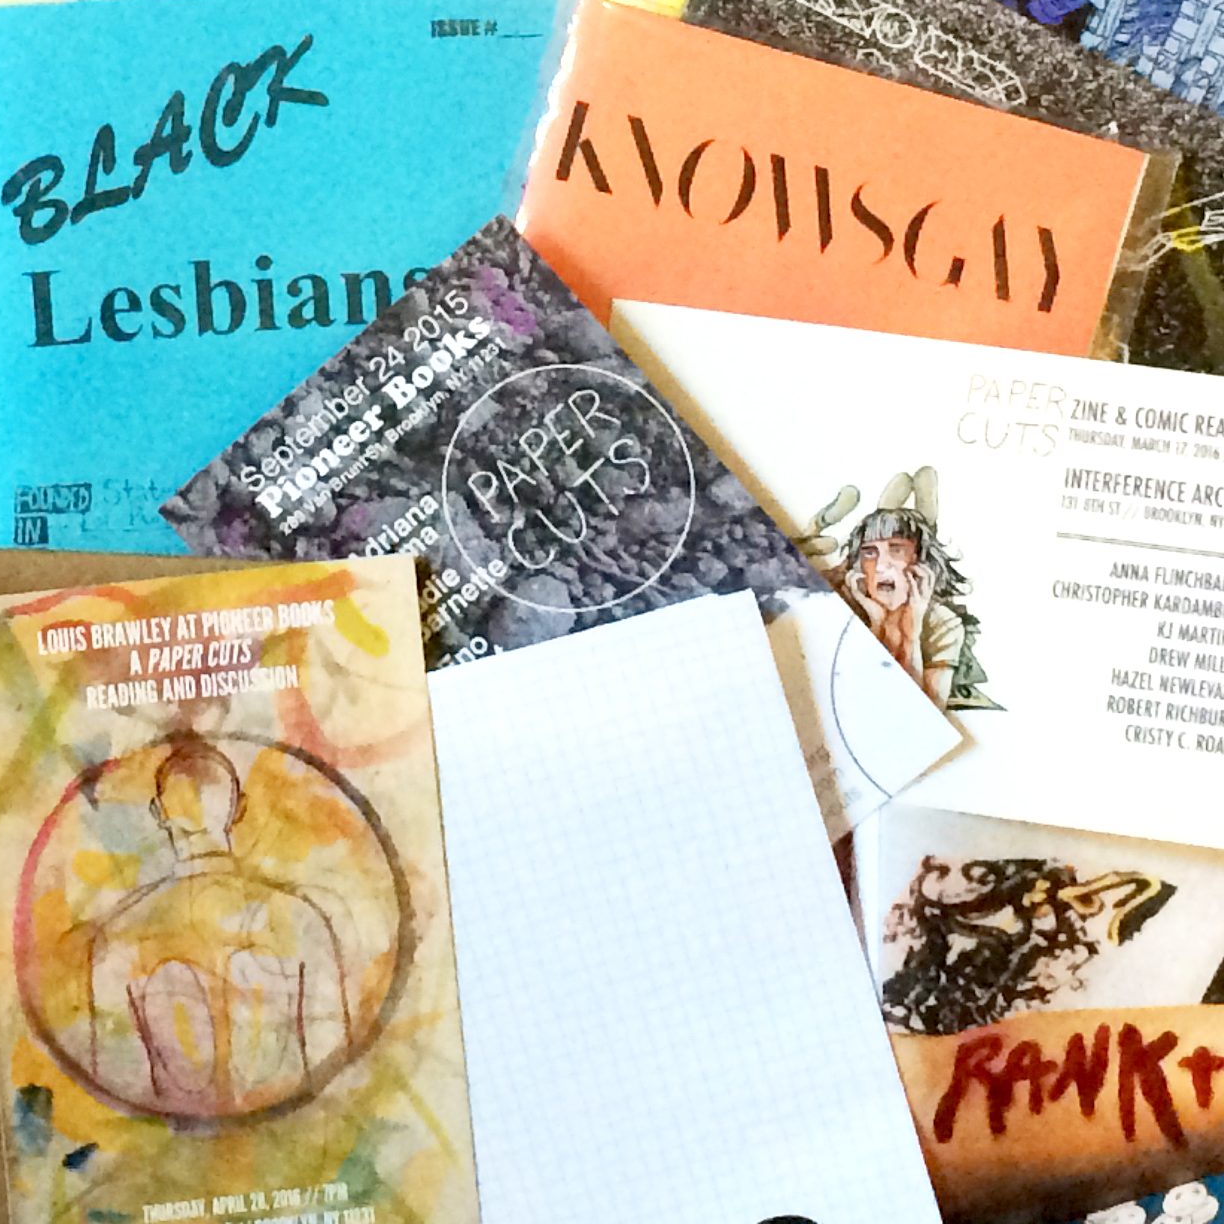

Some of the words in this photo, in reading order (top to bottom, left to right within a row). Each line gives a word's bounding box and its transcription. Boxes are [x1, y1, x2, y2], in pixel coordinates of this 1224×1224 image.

[431, 18, 481, 39] ISSUE
[0, 33, 330, 246] BLACK
[240, 374, 371, 493] September
[368, 344, 407, 384] 24
[403, 288, 470, 354] 2015
[967, 373, 1068, 419] PAPER
[254, 404, 385, 520] Pioneer
[381, 315, 493, 410] Books
[957, 411, 1060, 458] CUTS
[1070, 397, 1110, 425] ZINE
[1114, 406, 1128, 427] &
[1135, 406, 1190, 434] COMIC
[304, 487, 333, 513] Van
[444, 370, 466, 393] NY
[467, 387, 622, 524] PAPER
[1131, 435, 1171, 454] MARCH
[1193, 443, 1221, 460] 2016
[507, 435, 653, 571] CUTS
[1064, 467, 1187, 504] INTERFERENCE
[350, 494, 440, 558] driana
[1108, 500, 1122, 516] ST
[1109, 561, 1149, 583] ANNA
[1154, 566, 1224, 592] FLINCHBA
[1052, 579, 1150, 609] CHRISTOPHER
[1153, 593, 1224, 620] KARDAMB
[37, 626, 88, 656] LOUIS
[91, 616, 173, 650] BRAWLEY
[177, 613, 198, 640] AT
[201, 606, 274, 637] PIONEER
[276, 599, 337, 629] BOOKS
[1157, 620, 1174, 640] KJ
[129, 653, 144, 676] A
[147, 645, 203, 674] PAPER
[207, 637, 253, 665] CUTS
[1148, 646, 1191, 669] DREW
[86, 679, 159, 710] READING
[162, 675, 197, 702] AND
[200, 664, 299, 699] DISCUSSION
[1111, 667, 1154, 691] HAZEL
[1106, 694, 1161, 718] ROBERT
[1125, 723, 1175, 748] CRISTY
[212, 1194, 248, 1216] APRIL
[272, 1188, 302, 1208] 2016
